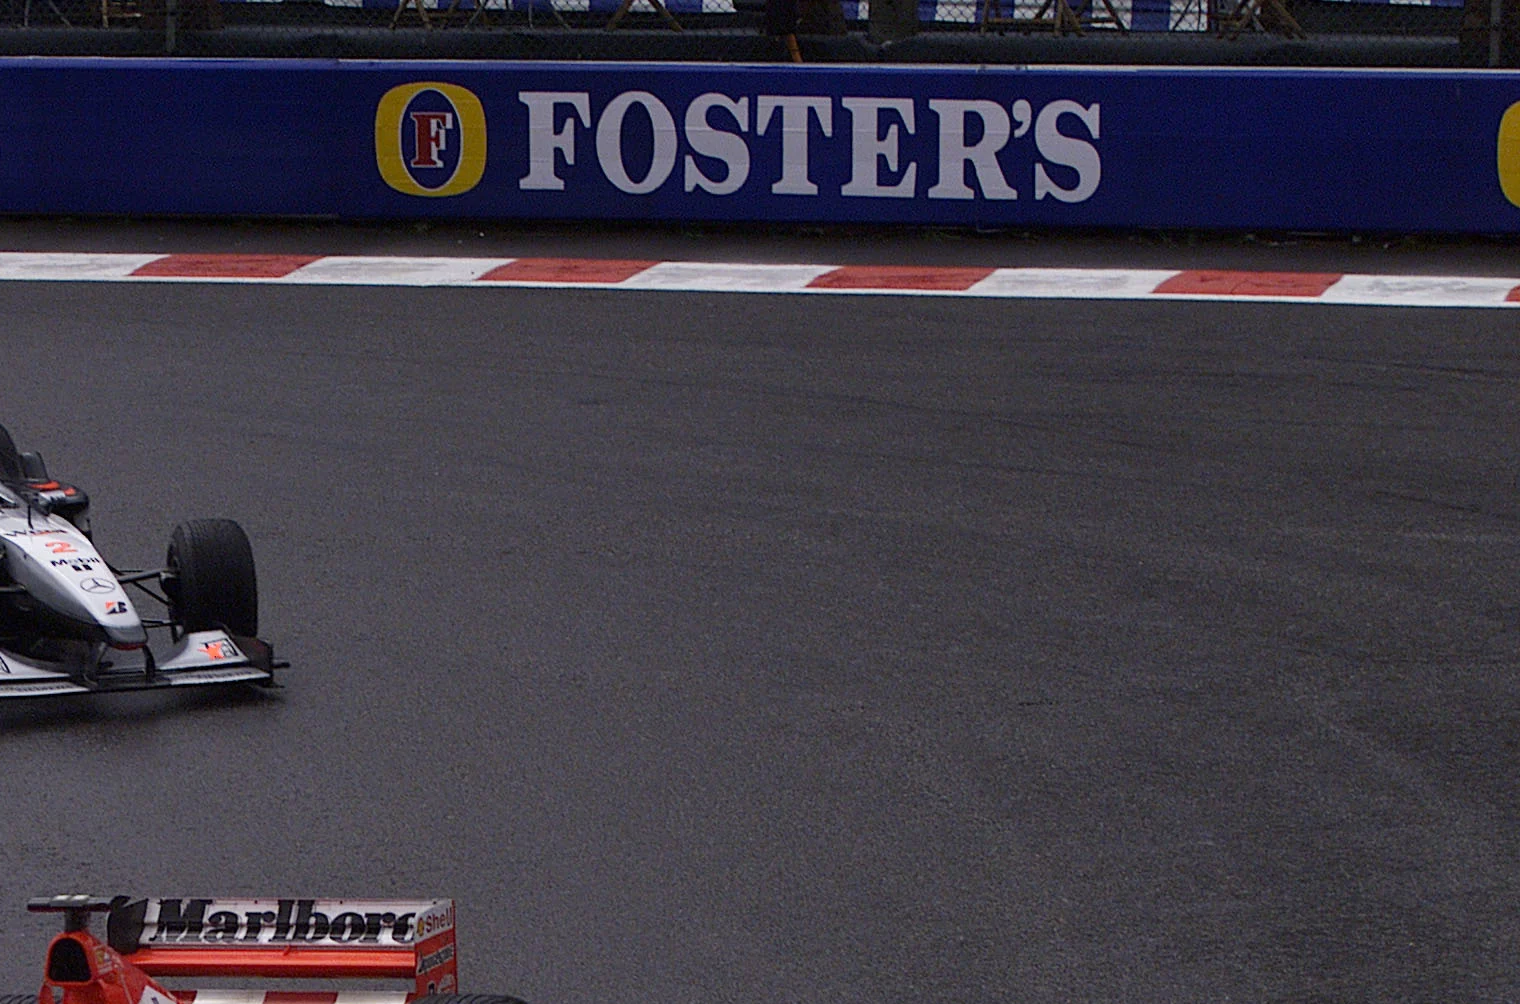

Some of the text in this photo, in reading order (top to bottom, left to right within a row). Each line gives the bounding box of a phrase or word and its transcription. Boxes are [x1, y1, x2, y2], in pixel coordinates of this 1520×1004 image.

[518, 91, 1101, 203] FOSTER'S
[45, 541, 78, 553] 2
[425, 907, 453, 933] Shell
